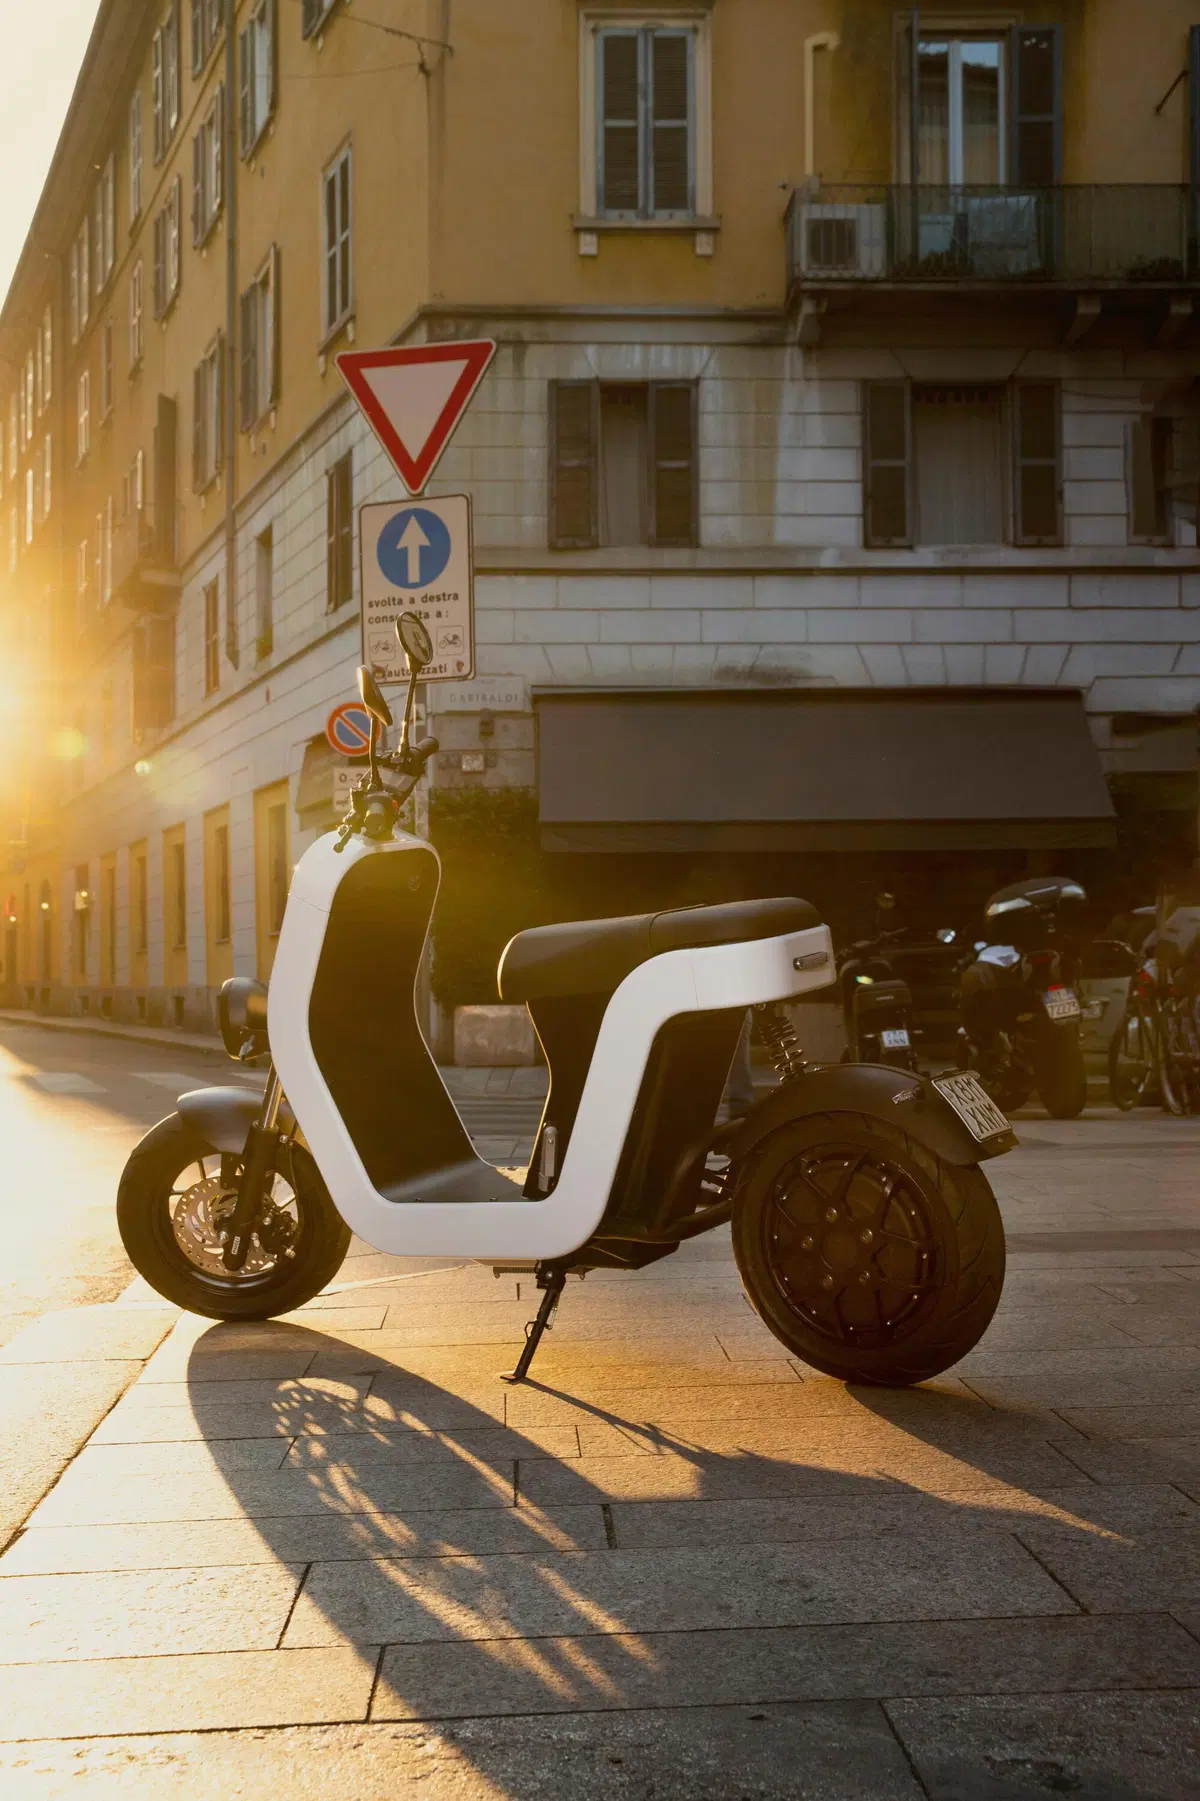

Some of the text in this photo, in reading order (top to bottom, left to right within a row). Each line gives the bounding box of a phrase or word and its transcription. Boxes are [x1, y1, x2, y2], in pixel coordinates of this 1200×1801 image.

[368, 592, 459, 608] svolta a destra
[368, 610, 430, 624] consita
[387, 664, 447, 677] autozzati
[965, 1102, 1006, 1134] XNM
